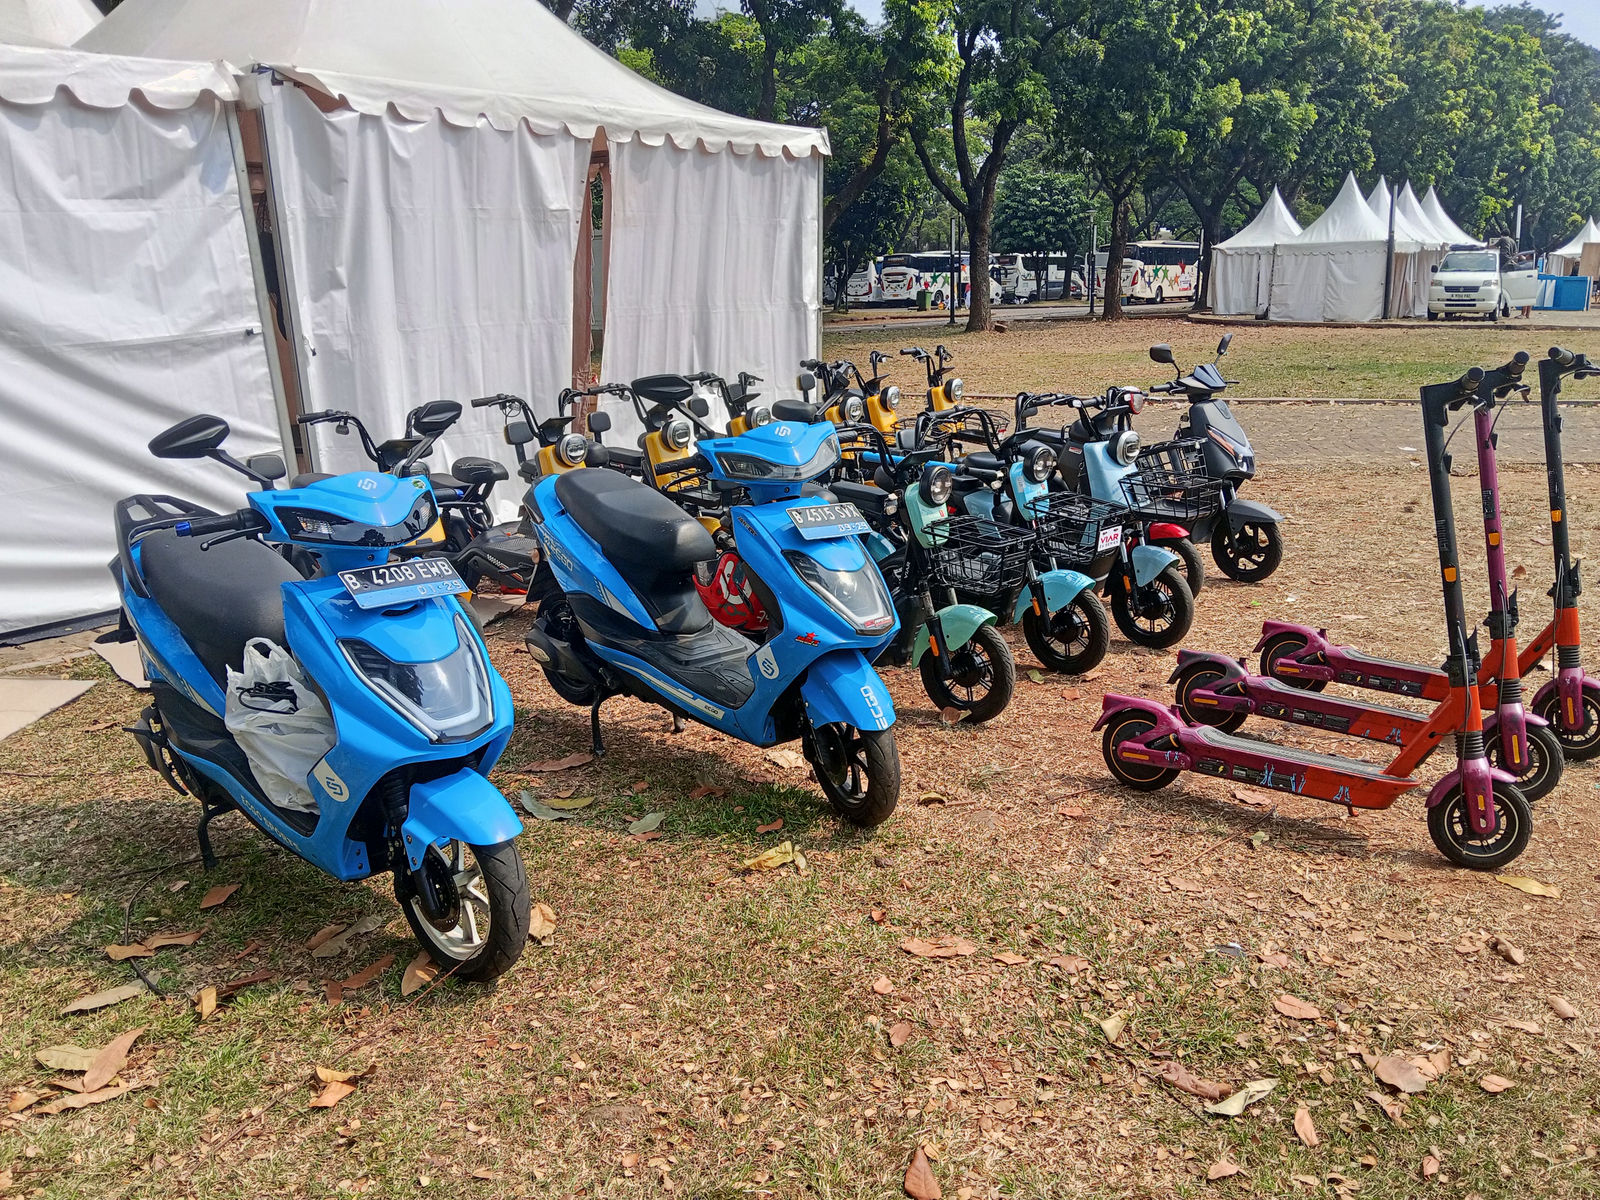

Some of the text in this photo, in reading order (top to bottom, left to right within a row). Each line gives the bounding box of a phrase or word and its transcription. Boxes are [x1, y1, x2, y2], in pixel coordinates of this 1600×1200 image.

[791, 503, 860, 523] B 4515 SVX
[1100, 533, 1119, 544] VIAR
[343, 561, 453, 591] B 4208 EWB
[704, 704, 719, 715] ECGO
[860, 685, 889, 731] ECGO
